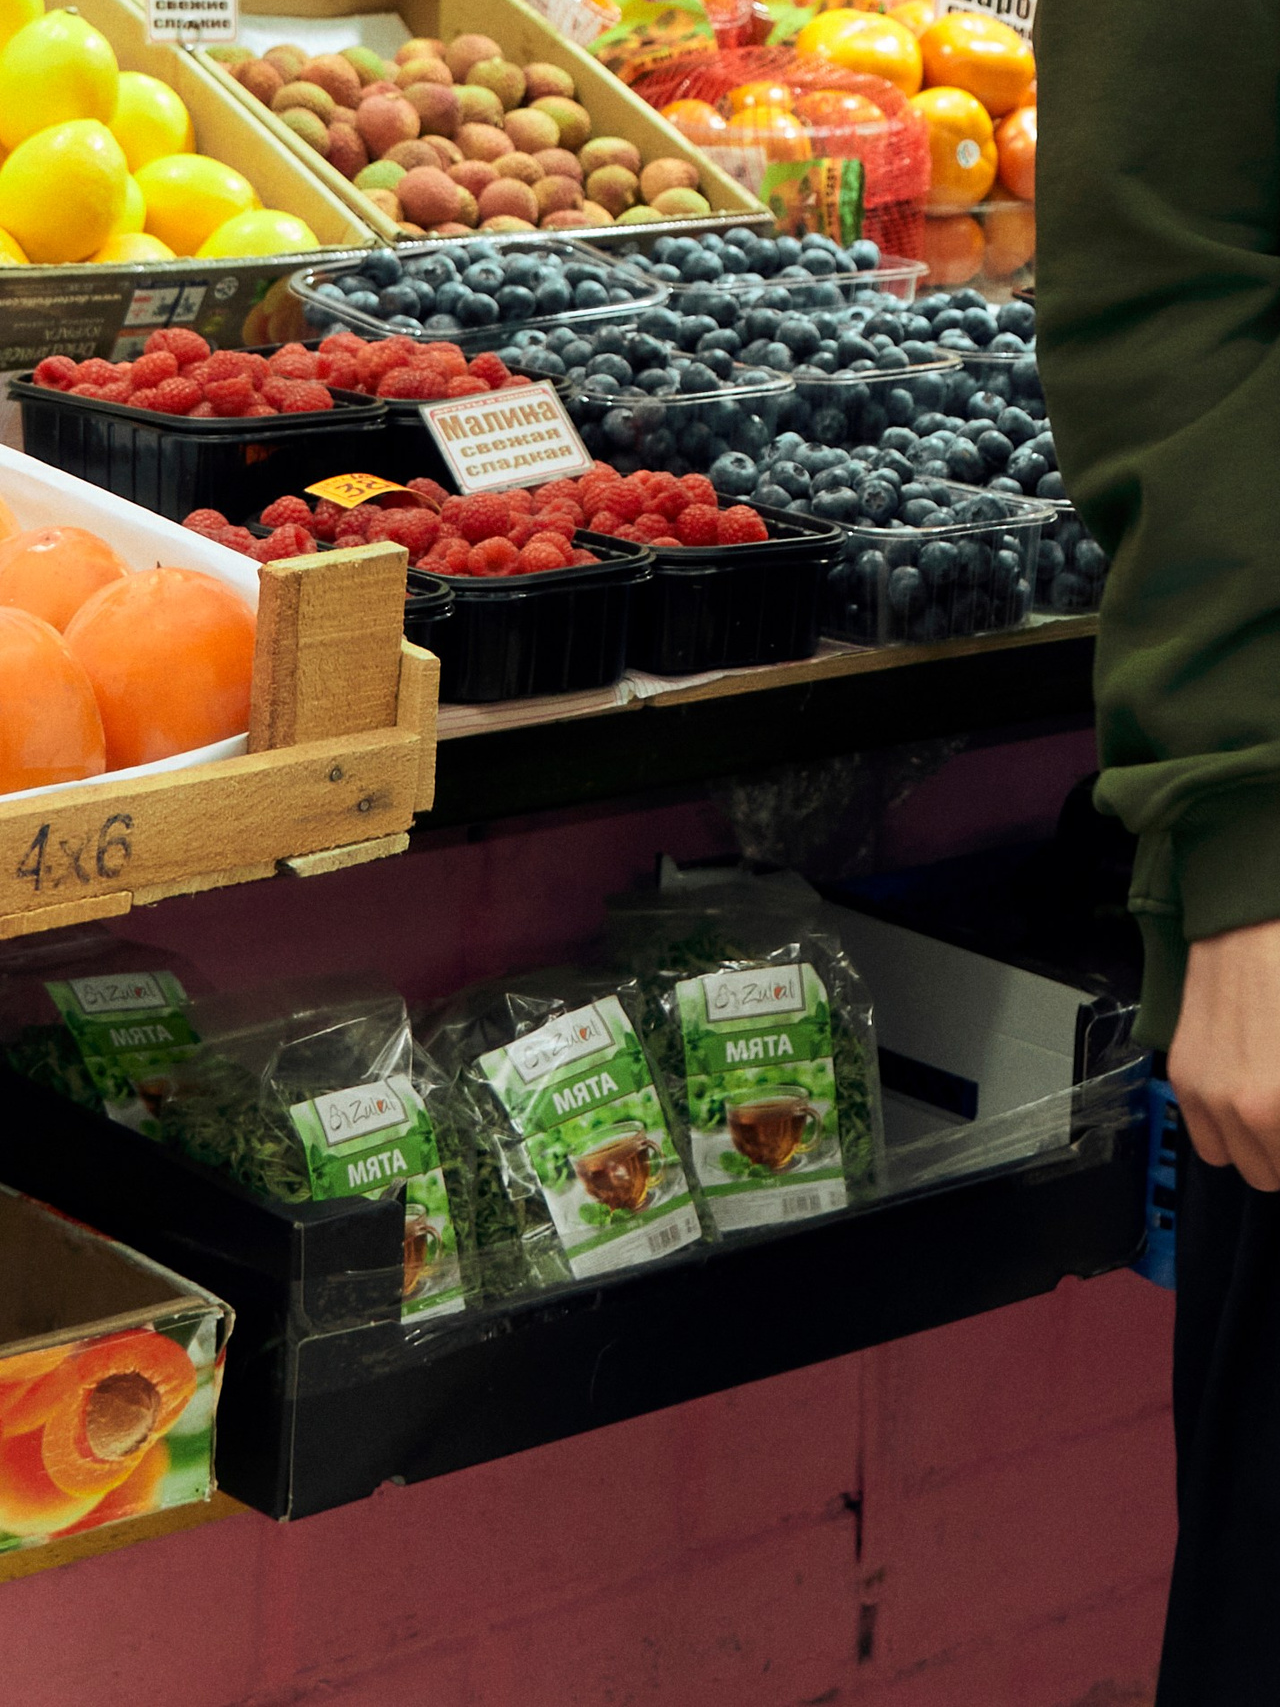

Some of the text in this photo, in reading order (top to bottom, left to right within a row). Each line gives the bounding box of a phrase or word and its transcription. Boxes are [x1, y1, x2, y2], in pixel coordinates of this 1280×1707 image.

[155, 0, 228, 11] свежие
[437, 400, 559, 442] Малина
[460, 427, 562, 458] свежая
[465, 445, 573, 477] сладкая
[109, 1024, 174, 1047] МЯТА
[725, 1034, 794, 1063] МЯТА
[552, 1071, 620, 1115] МЯТА
[347, 1148, 408, 1188] МЯТА
